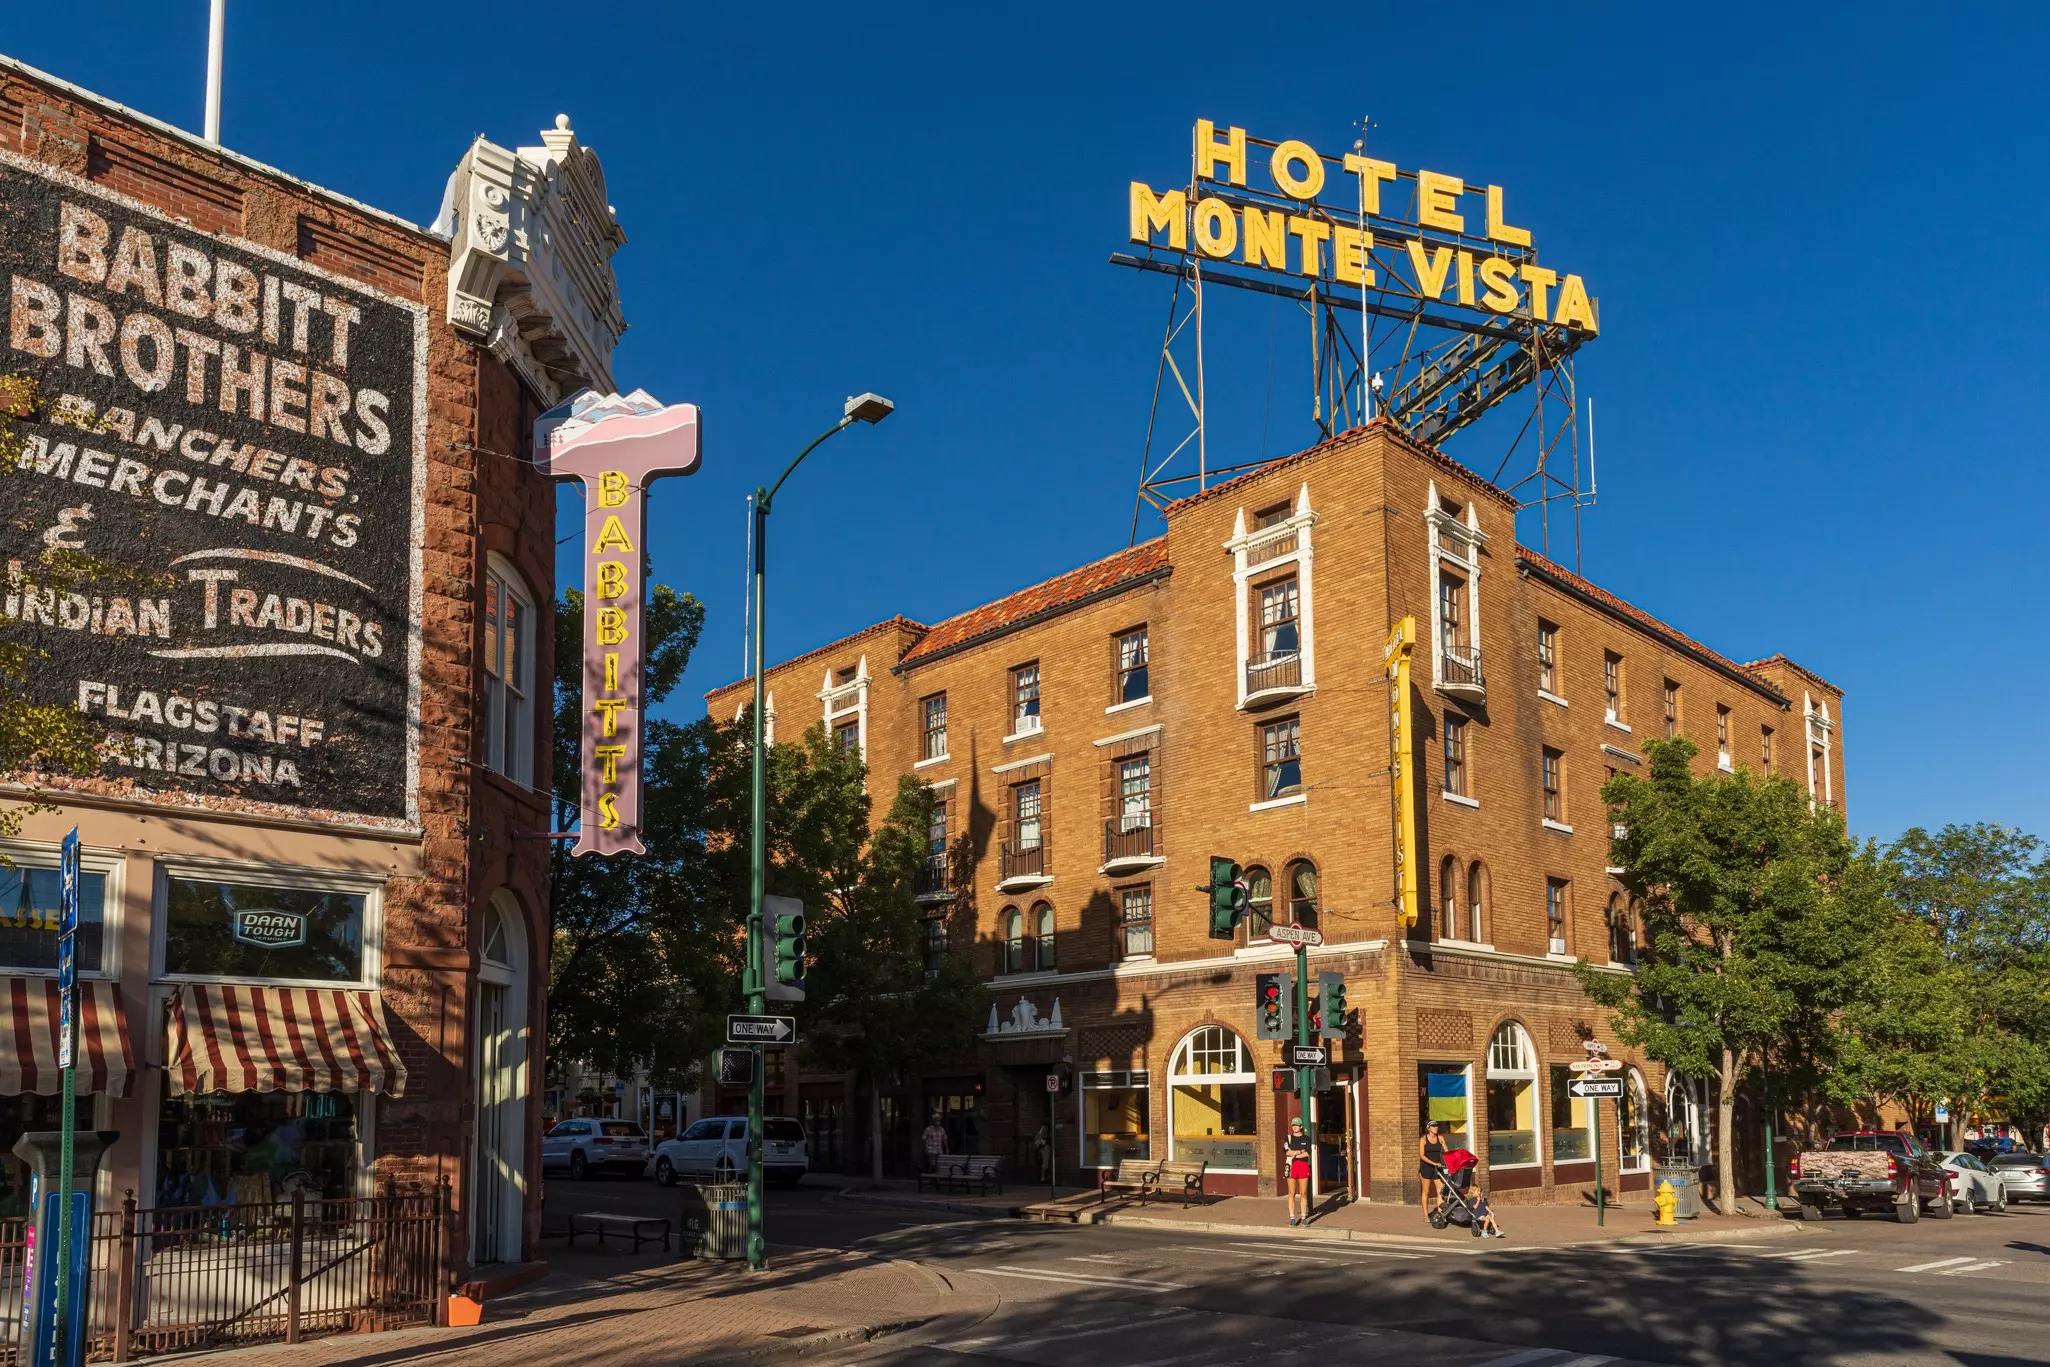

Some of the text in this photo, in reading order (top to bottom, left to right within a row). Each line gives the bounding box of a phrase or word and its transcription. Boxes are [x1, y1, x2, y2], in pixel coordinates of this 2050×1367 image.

[1194, 118, 1531, 248] HOTEL
[58, 200, 361, 370] BABBITT
[1129, 181, 1598, 338] MONTE VISTA
[10, 274, 391, 456] BROTHERS
[17, 433, 361, 548] MERCHANTS
[43, 502, 96, 550] &
[5, 559, 383, 658] INDIAN TRADERS
[592, 470, 635, 832] BABBITTS
[78, 680, 325, 748] FLAGSTAFF
[244, 914, 298, 928] DARN
[244, 926, 295, 938] TOUGH
[1277, 928, 1316, 942] ASPEN AVE
[735, 1023, 775, 1035] ONE WAY
[1297, 1051, 1306, 1059] ONE
[1584, 1084, 1616, 1092] ONE WAY
